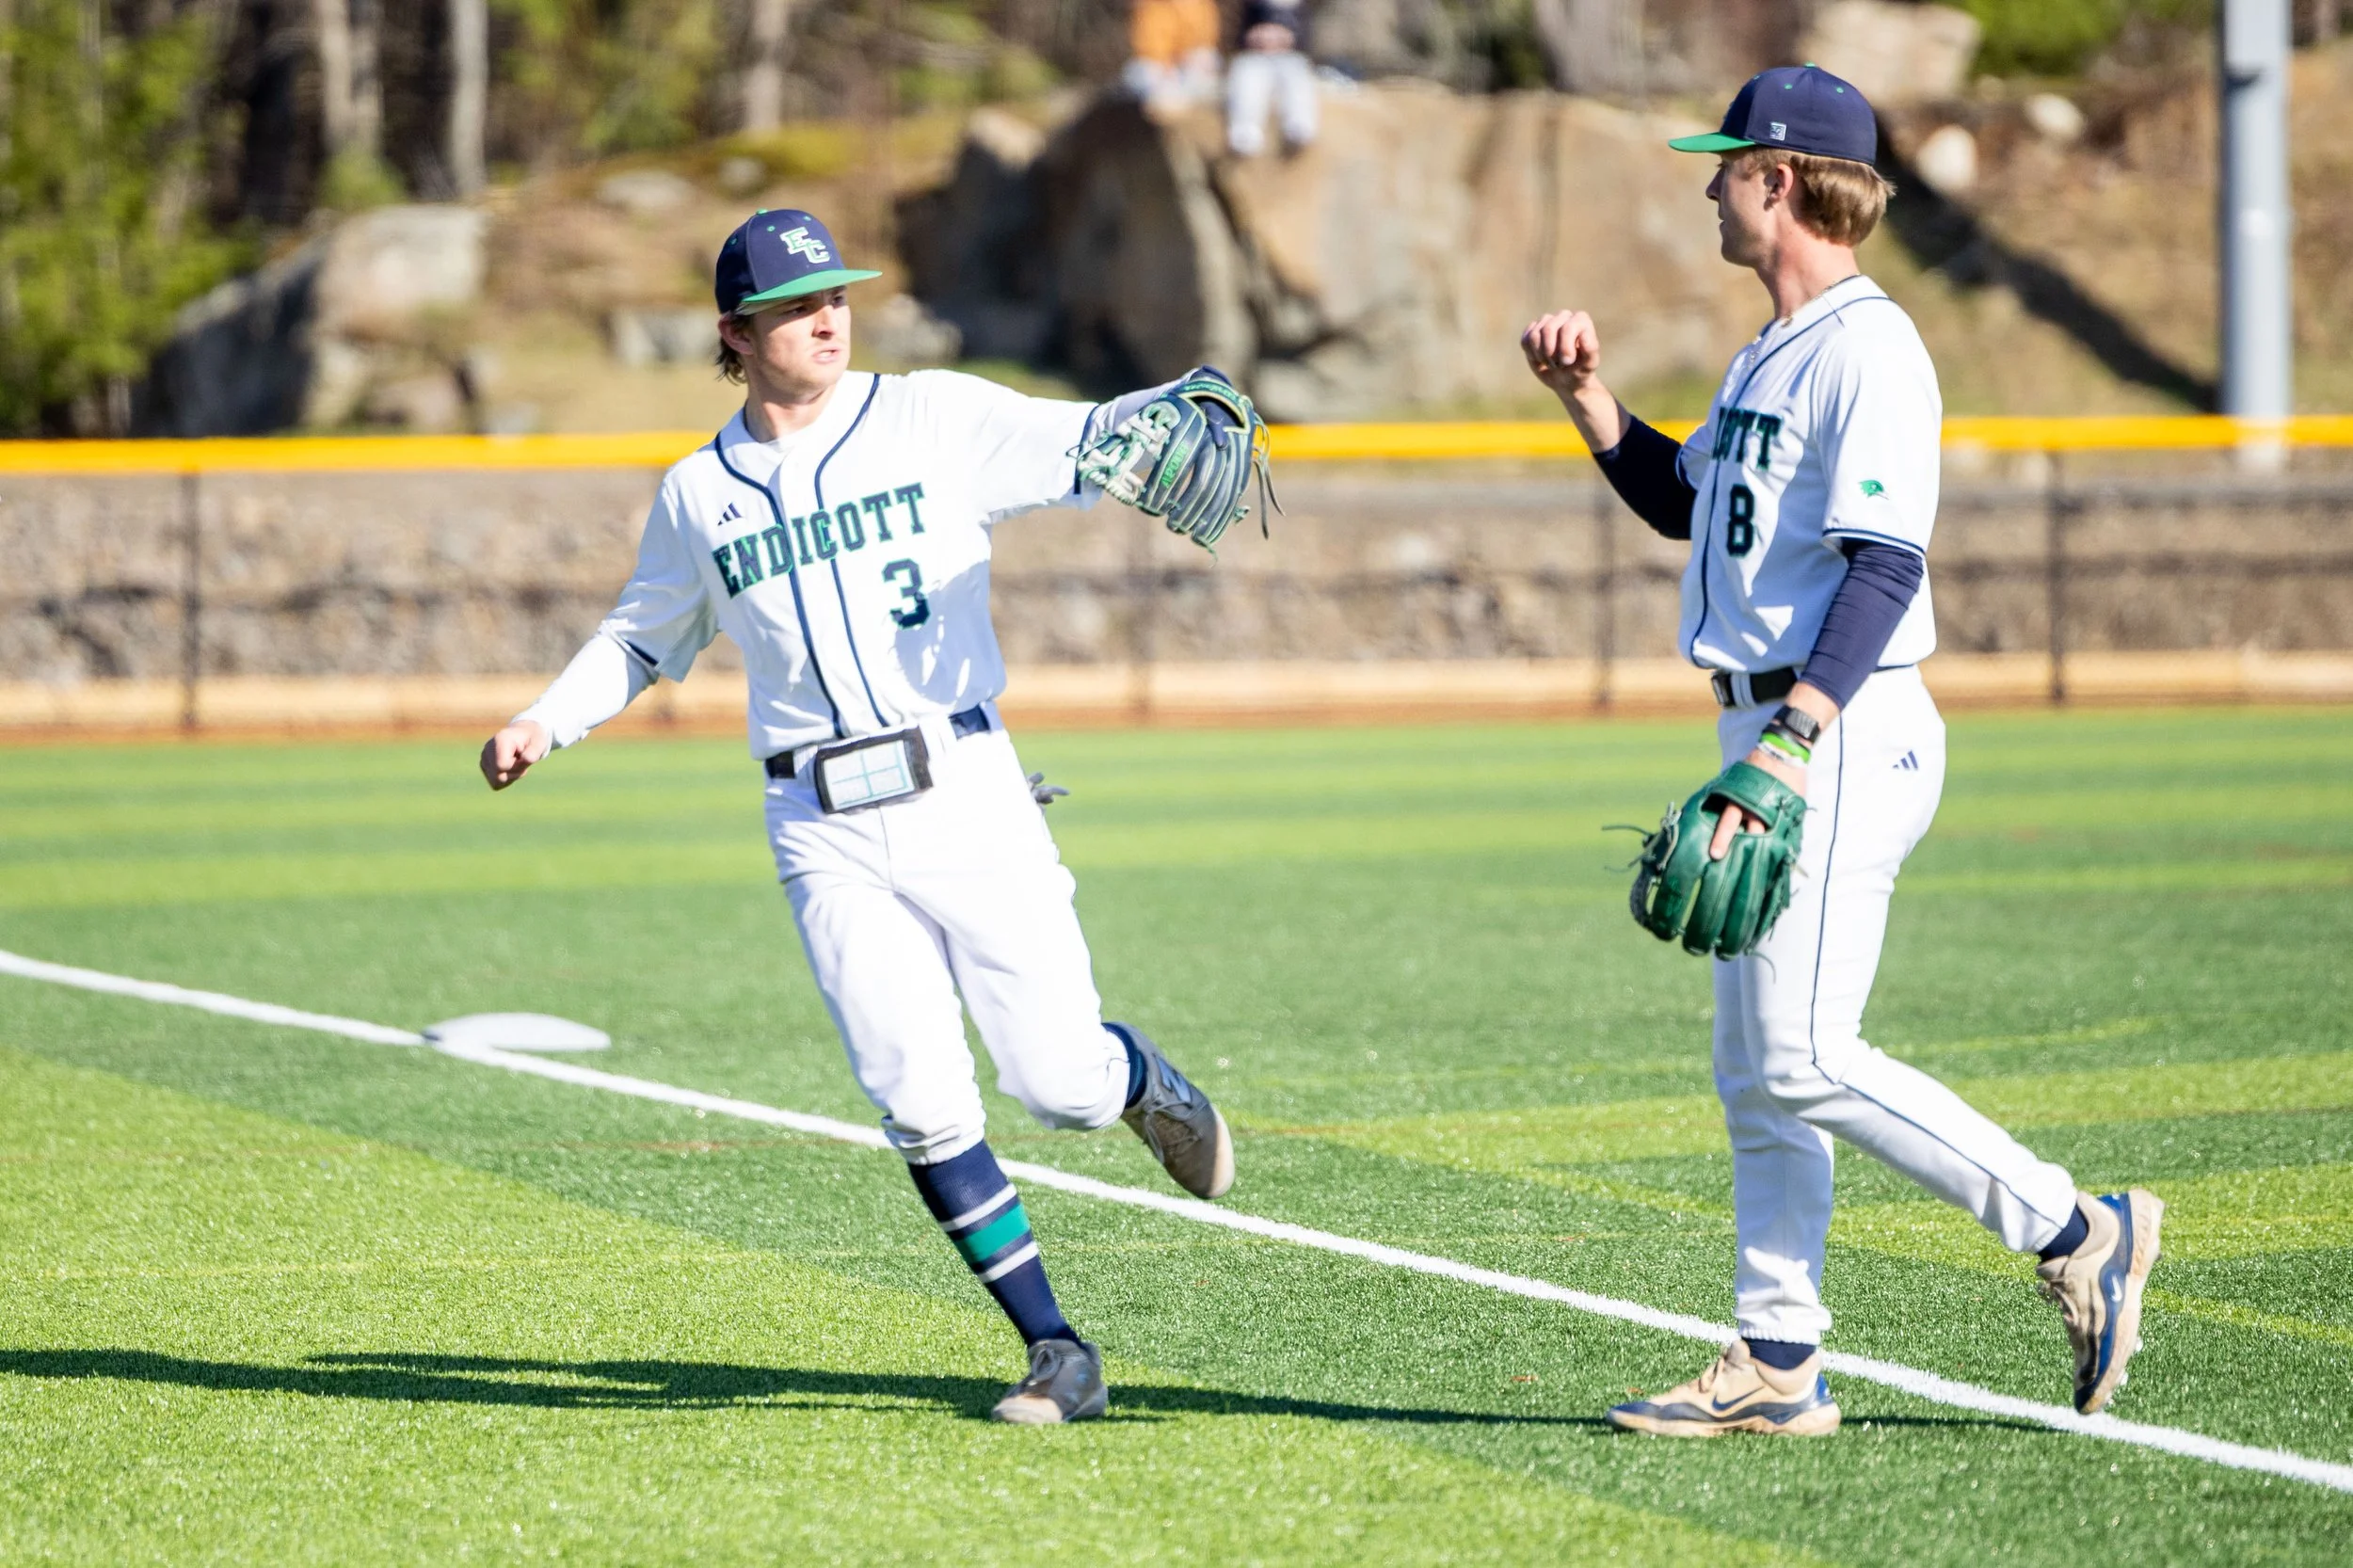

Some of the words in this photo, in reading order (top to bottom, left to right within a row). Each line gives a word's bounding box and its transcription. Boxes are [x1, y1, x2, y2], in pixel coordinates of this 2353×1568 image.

[779, 227, 830, 264] EC
[712, 482, 925, 599] ENDICOTT
[1727, 484, 1754, 557] 8
[882, 558, 931, 630] 3
